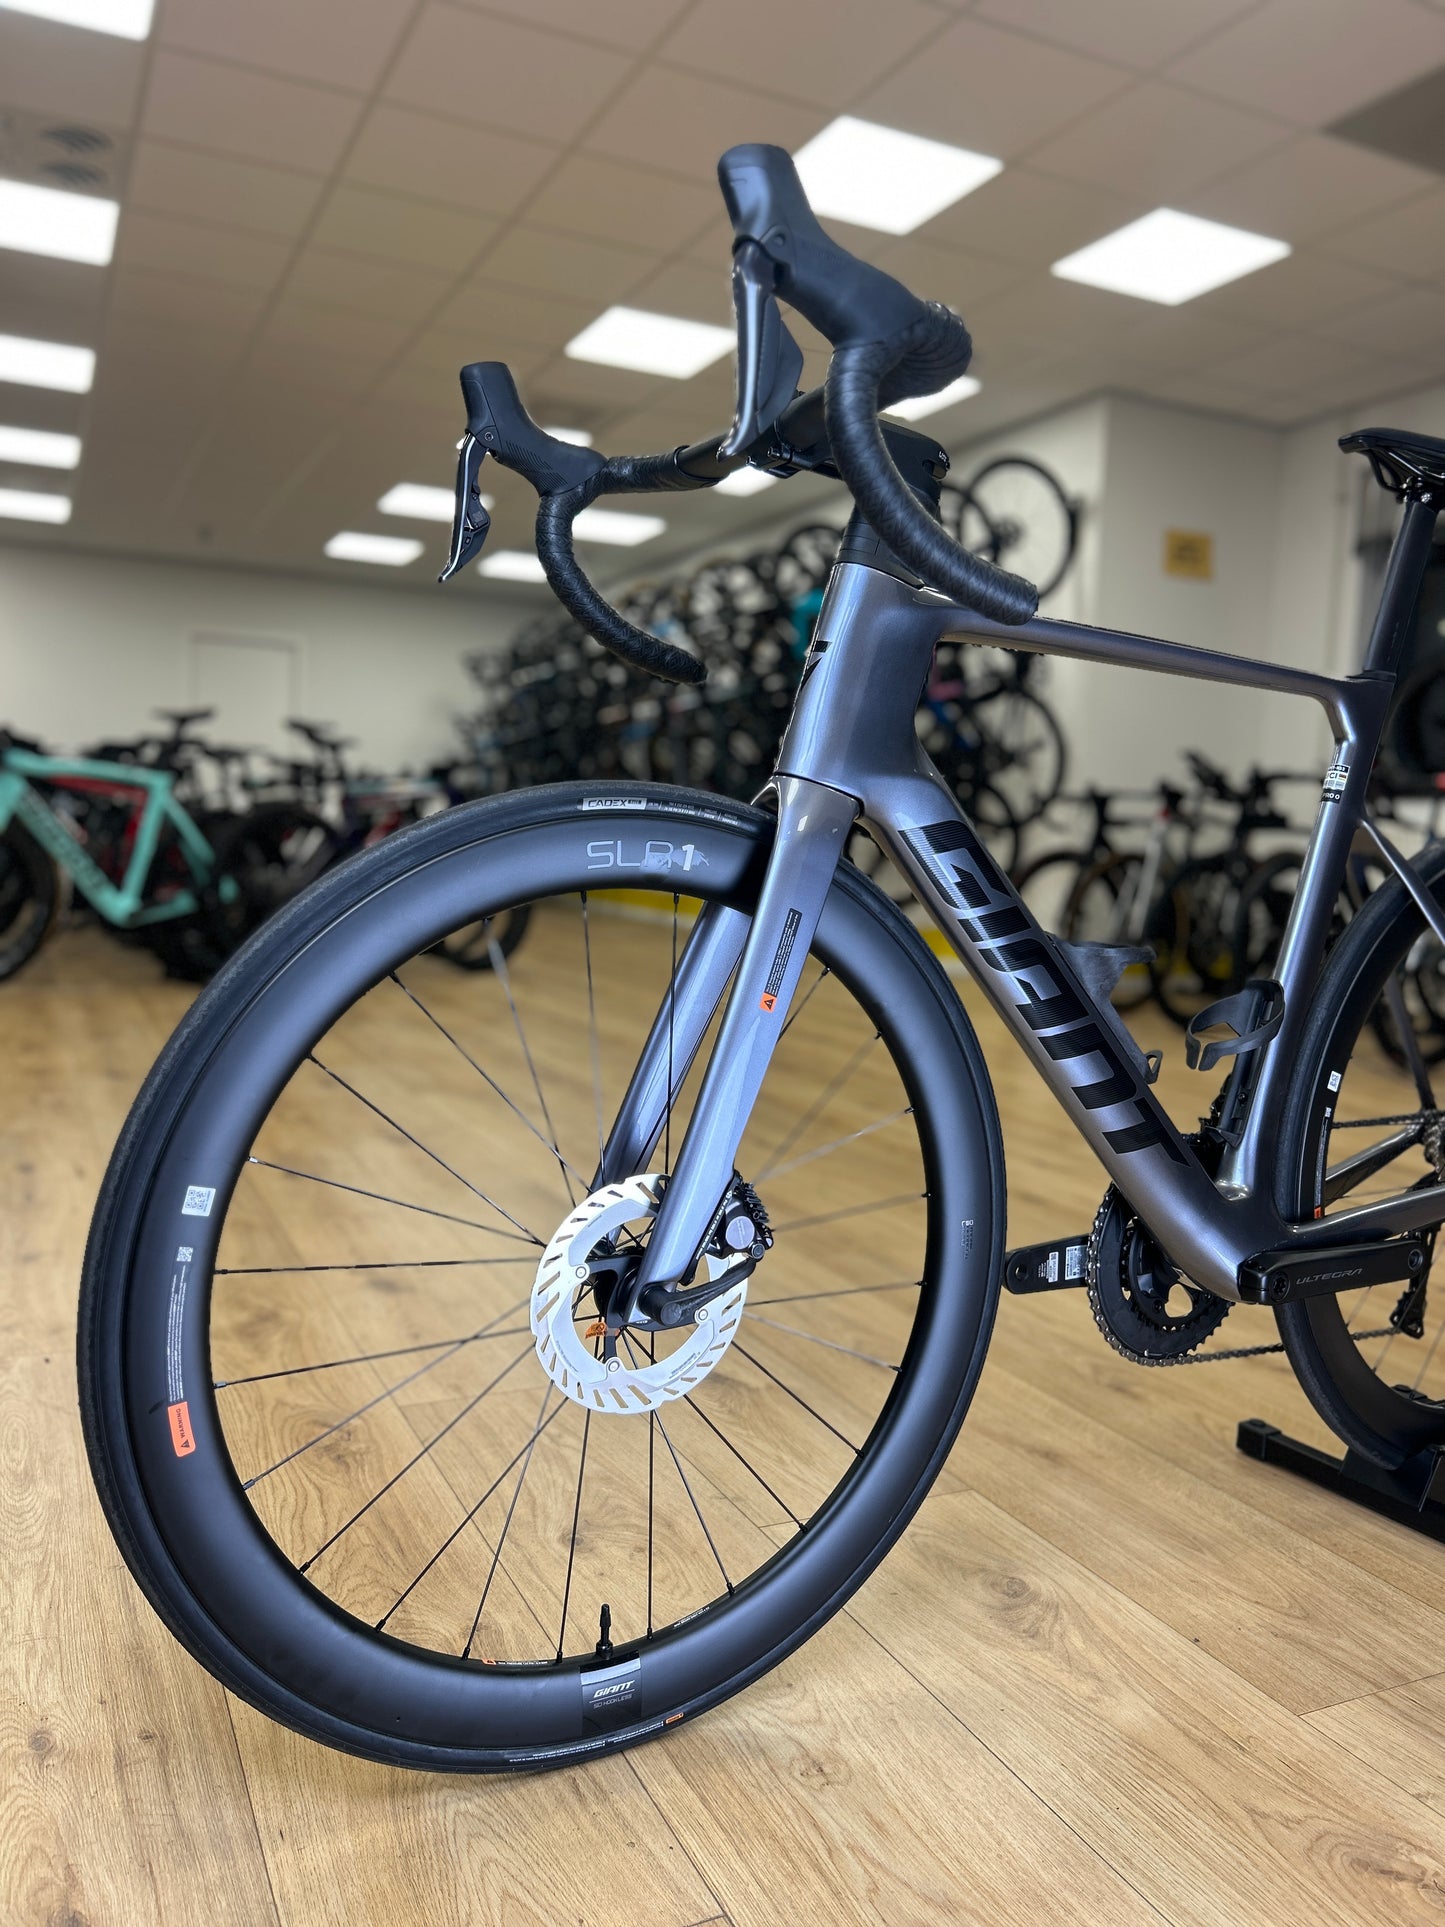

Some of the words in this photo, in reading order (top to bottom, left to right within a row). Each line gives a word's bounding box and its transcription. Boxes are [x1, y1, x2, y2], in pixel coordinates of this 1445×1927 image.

[588, 799, 627, 808] CADEX
[898, 820, 1191, 1167] GIANT
[1296, 1268, 1363, 1285] ULTEGRA
[175, 1408, 185, 1439] WARNING
[593, 1680, 636, 1698] GIANT
